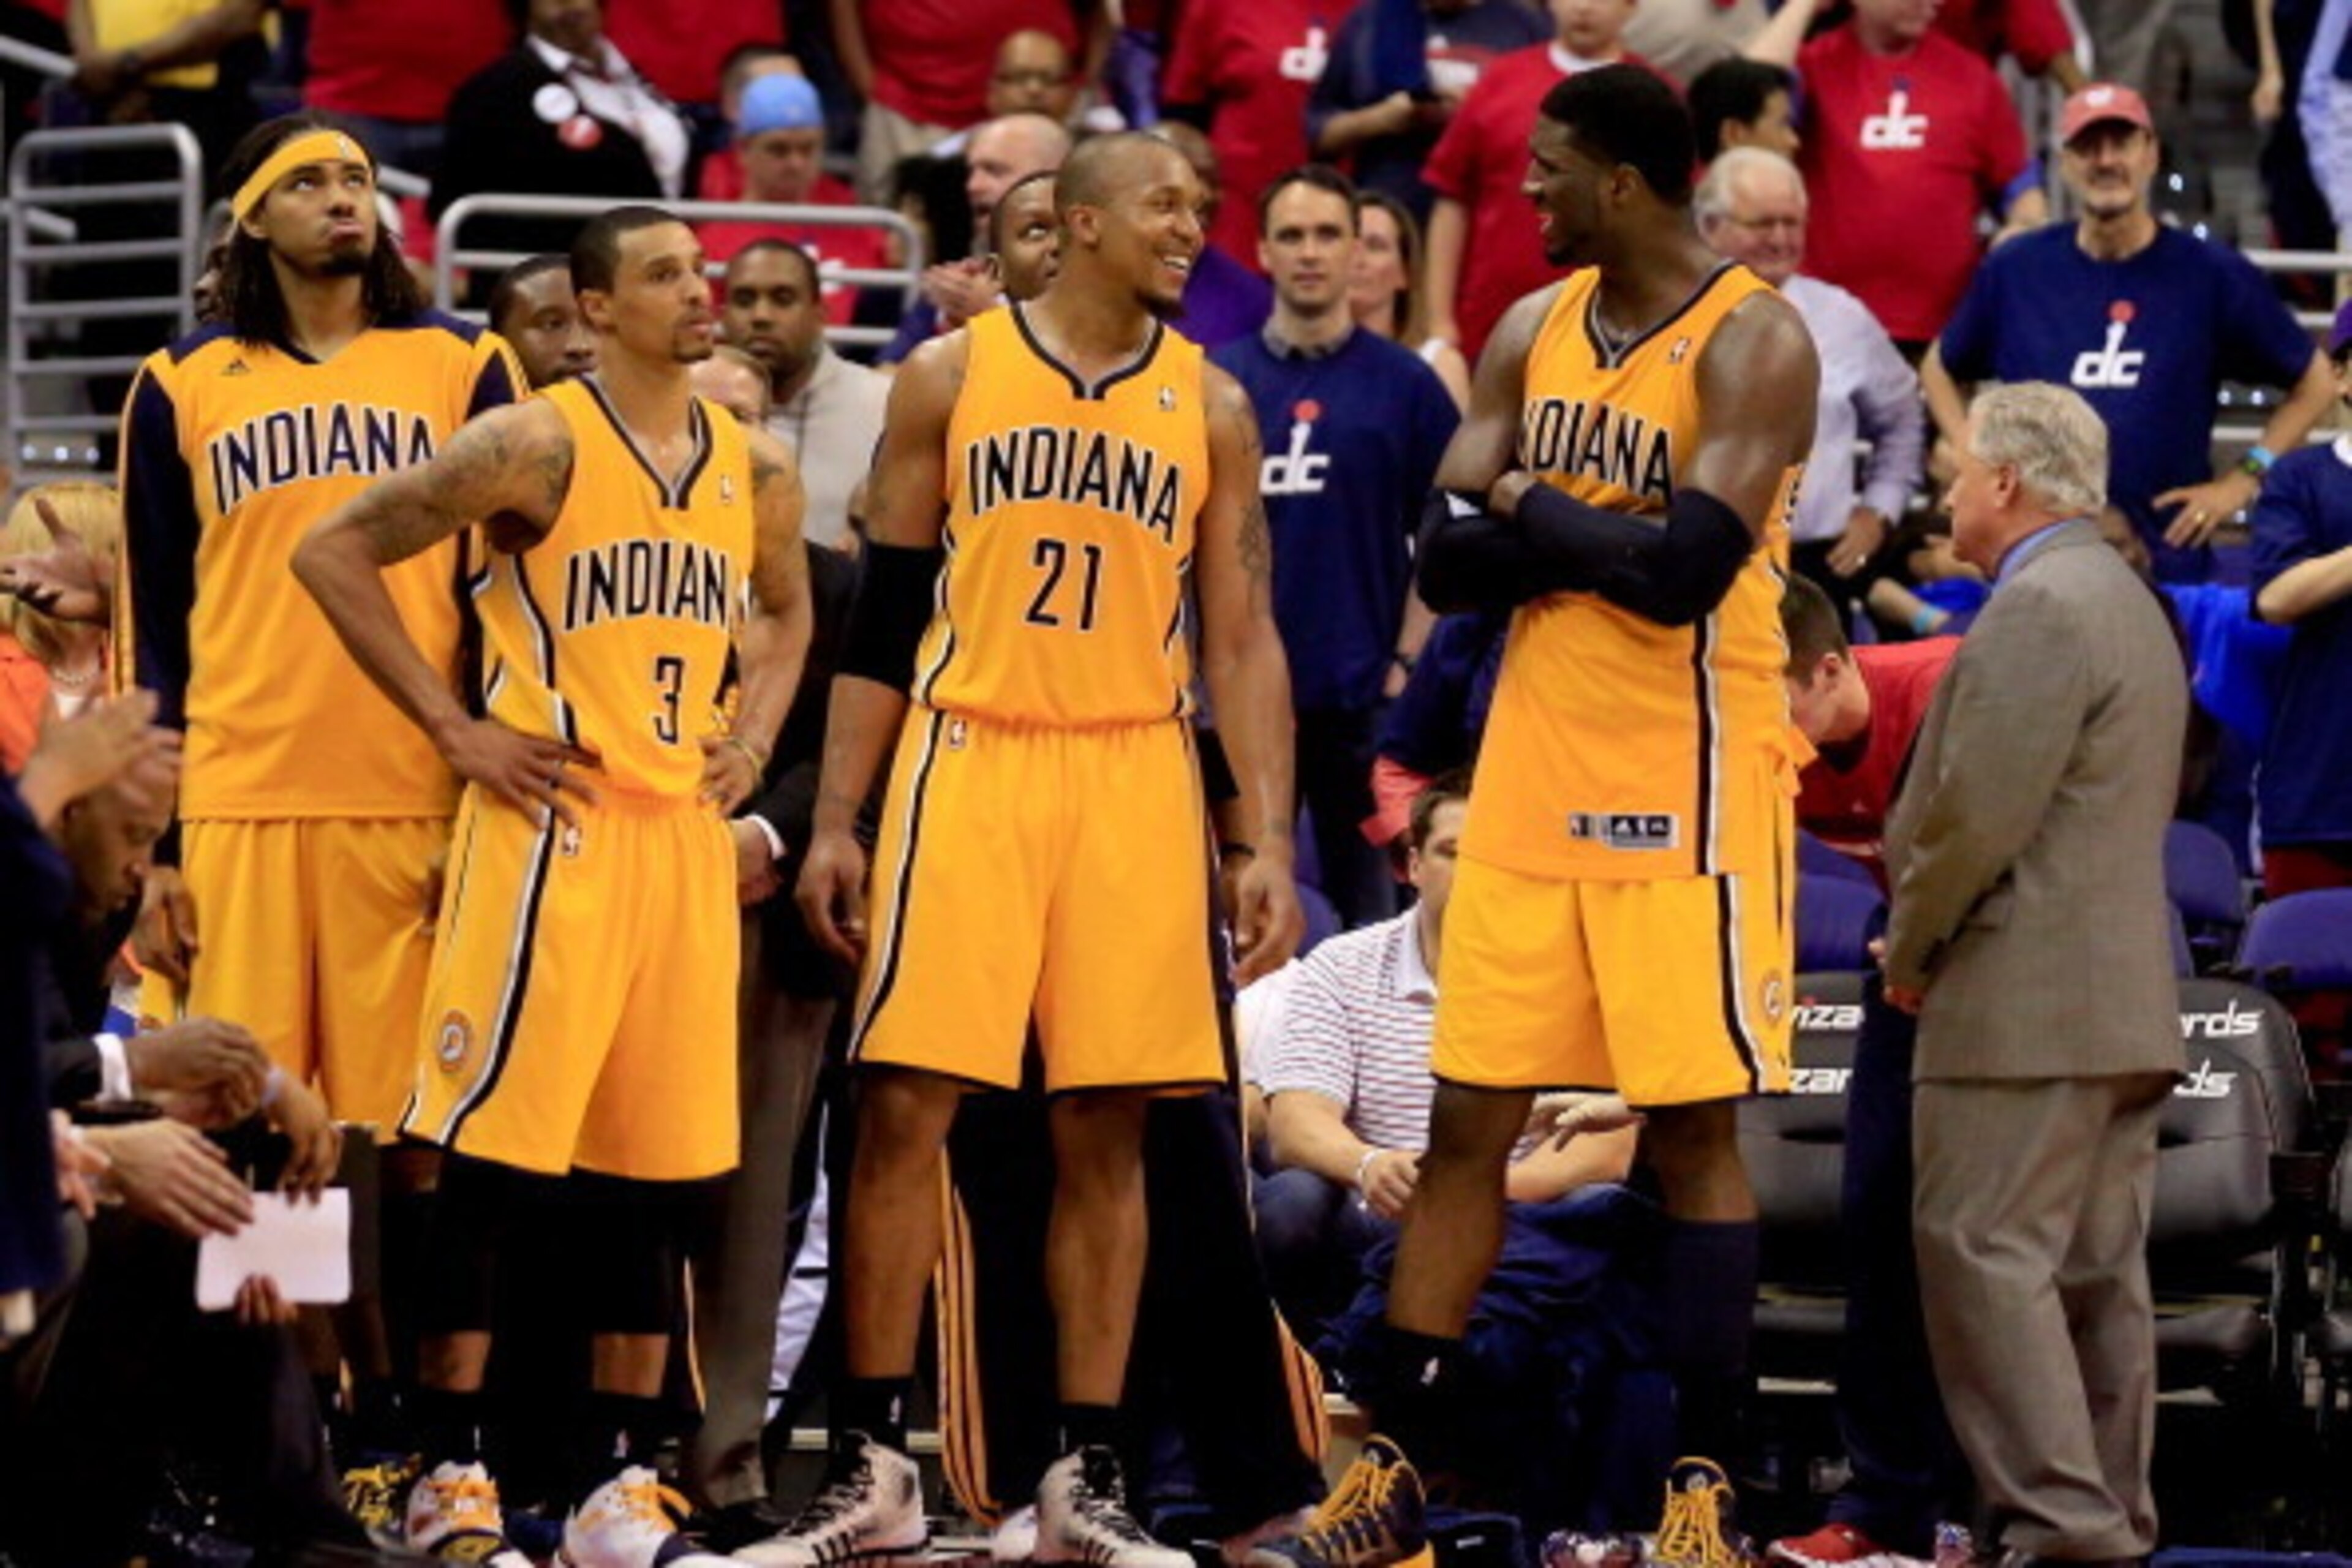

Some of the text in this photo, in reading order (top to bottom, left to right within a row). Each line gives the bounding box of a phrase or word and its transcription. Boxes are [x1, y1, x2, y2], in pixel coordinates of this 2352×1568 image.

[1860, 91, 1929, 149] dc
[2070, 320, 2145, 387] dc
[967, 425, 1181, 546] INDIANA
[1259, 421, 1331, 495] dc
[1523, 397, 1673, 508] DIANA
[562, 537, 729, 633] INDIAN
[1024, 536, 1104, 633] 21
[653, 654, 686, 746] 3
